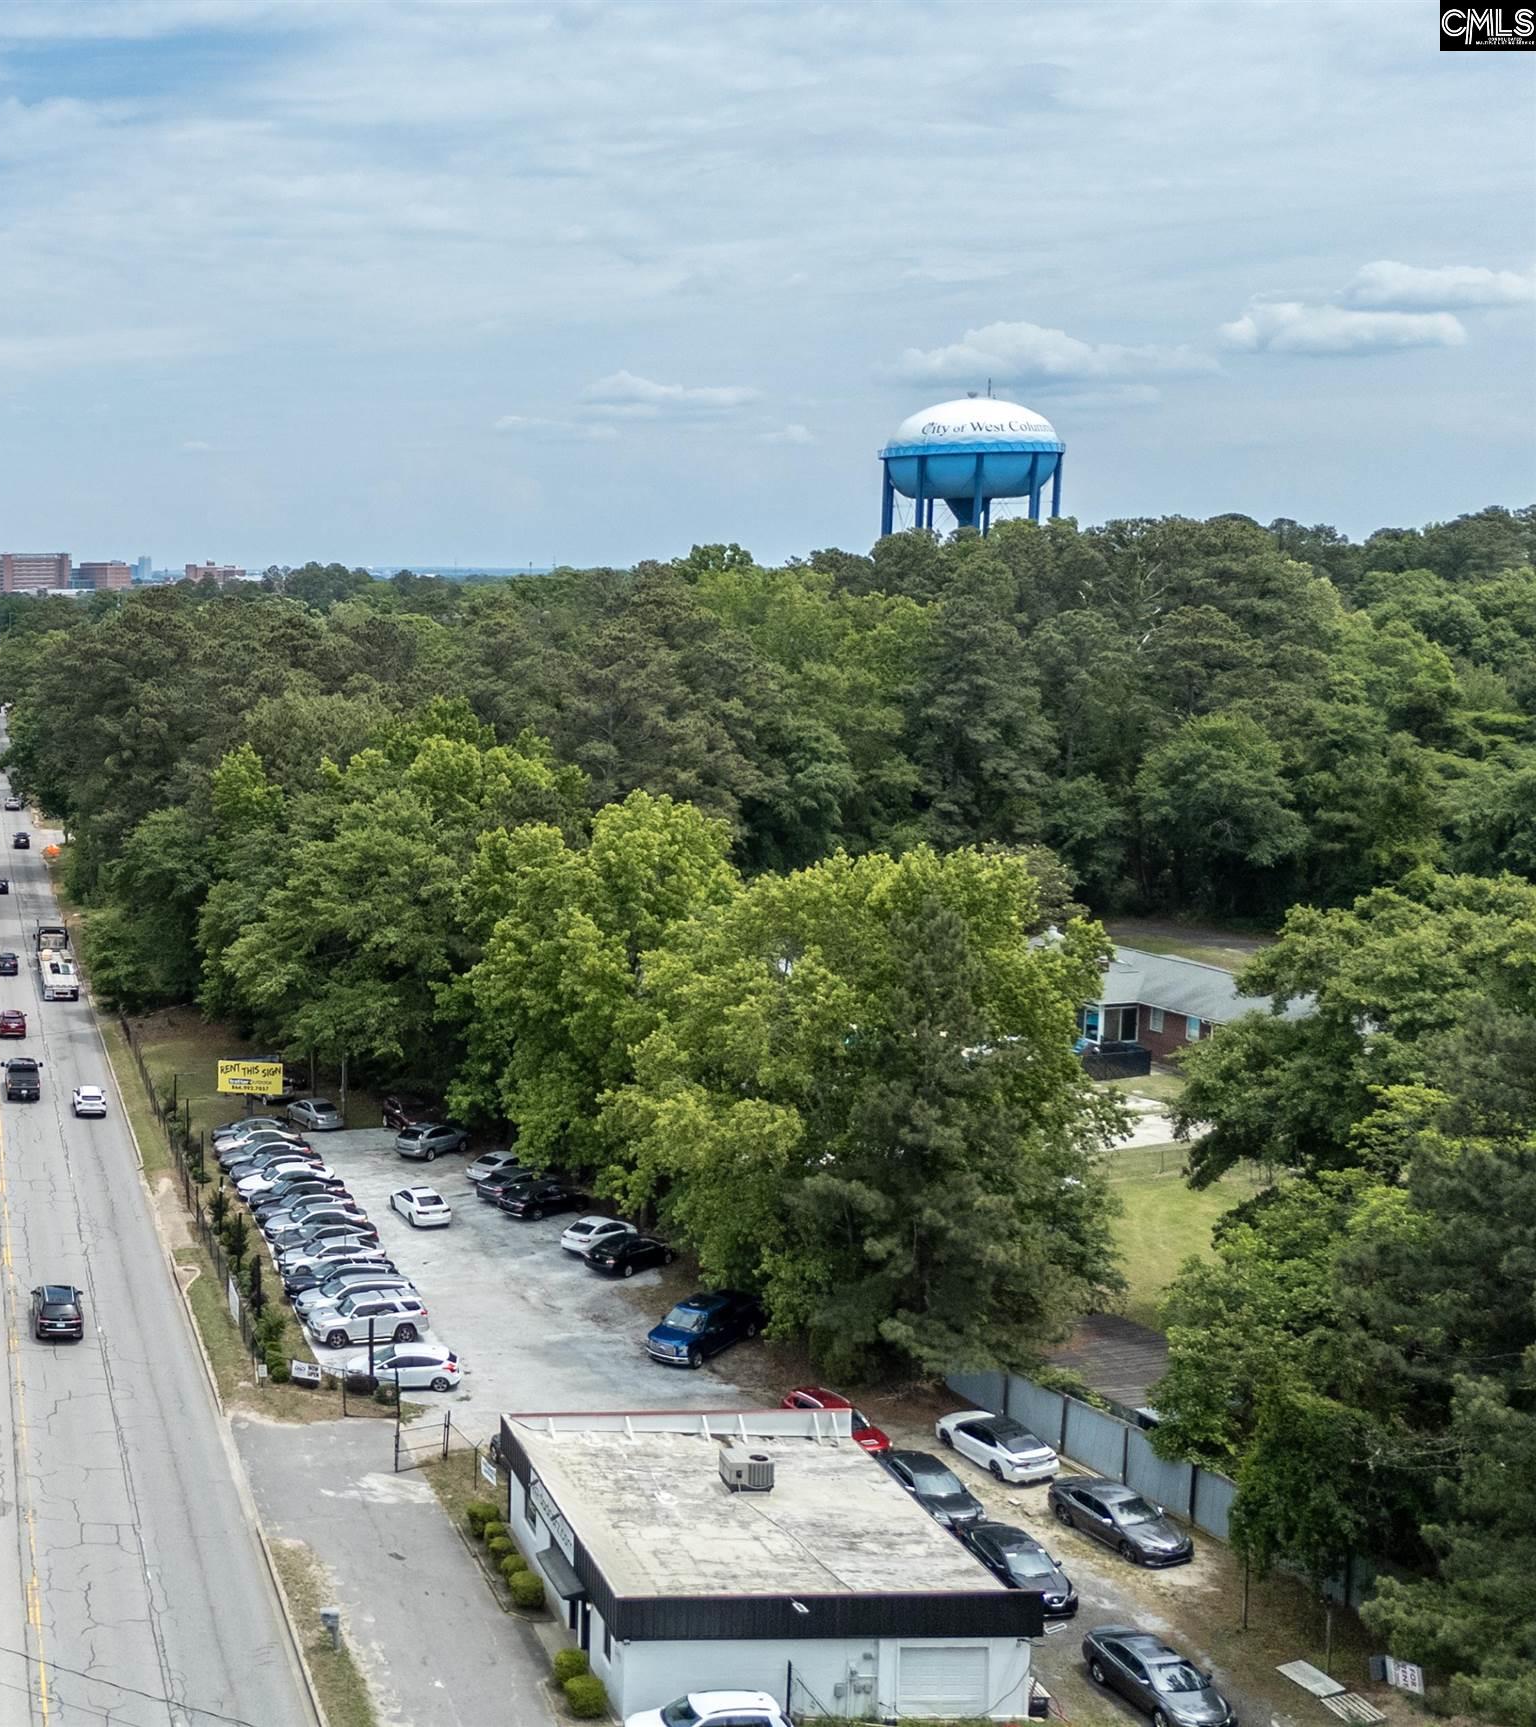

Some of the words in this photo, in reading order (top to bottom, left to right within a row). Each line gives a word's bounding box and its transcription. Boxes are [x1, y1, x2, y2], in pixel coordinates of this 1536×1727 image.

[921, 421, 948, 437] City
[953, 424, 965, 433] of
[970, 421, 1004, 432] West
[220, 1063, 240, 1074] RENT
[241, 1065, 260, 1077] THIS
[261, 1066, 281, 1078] SIGN
